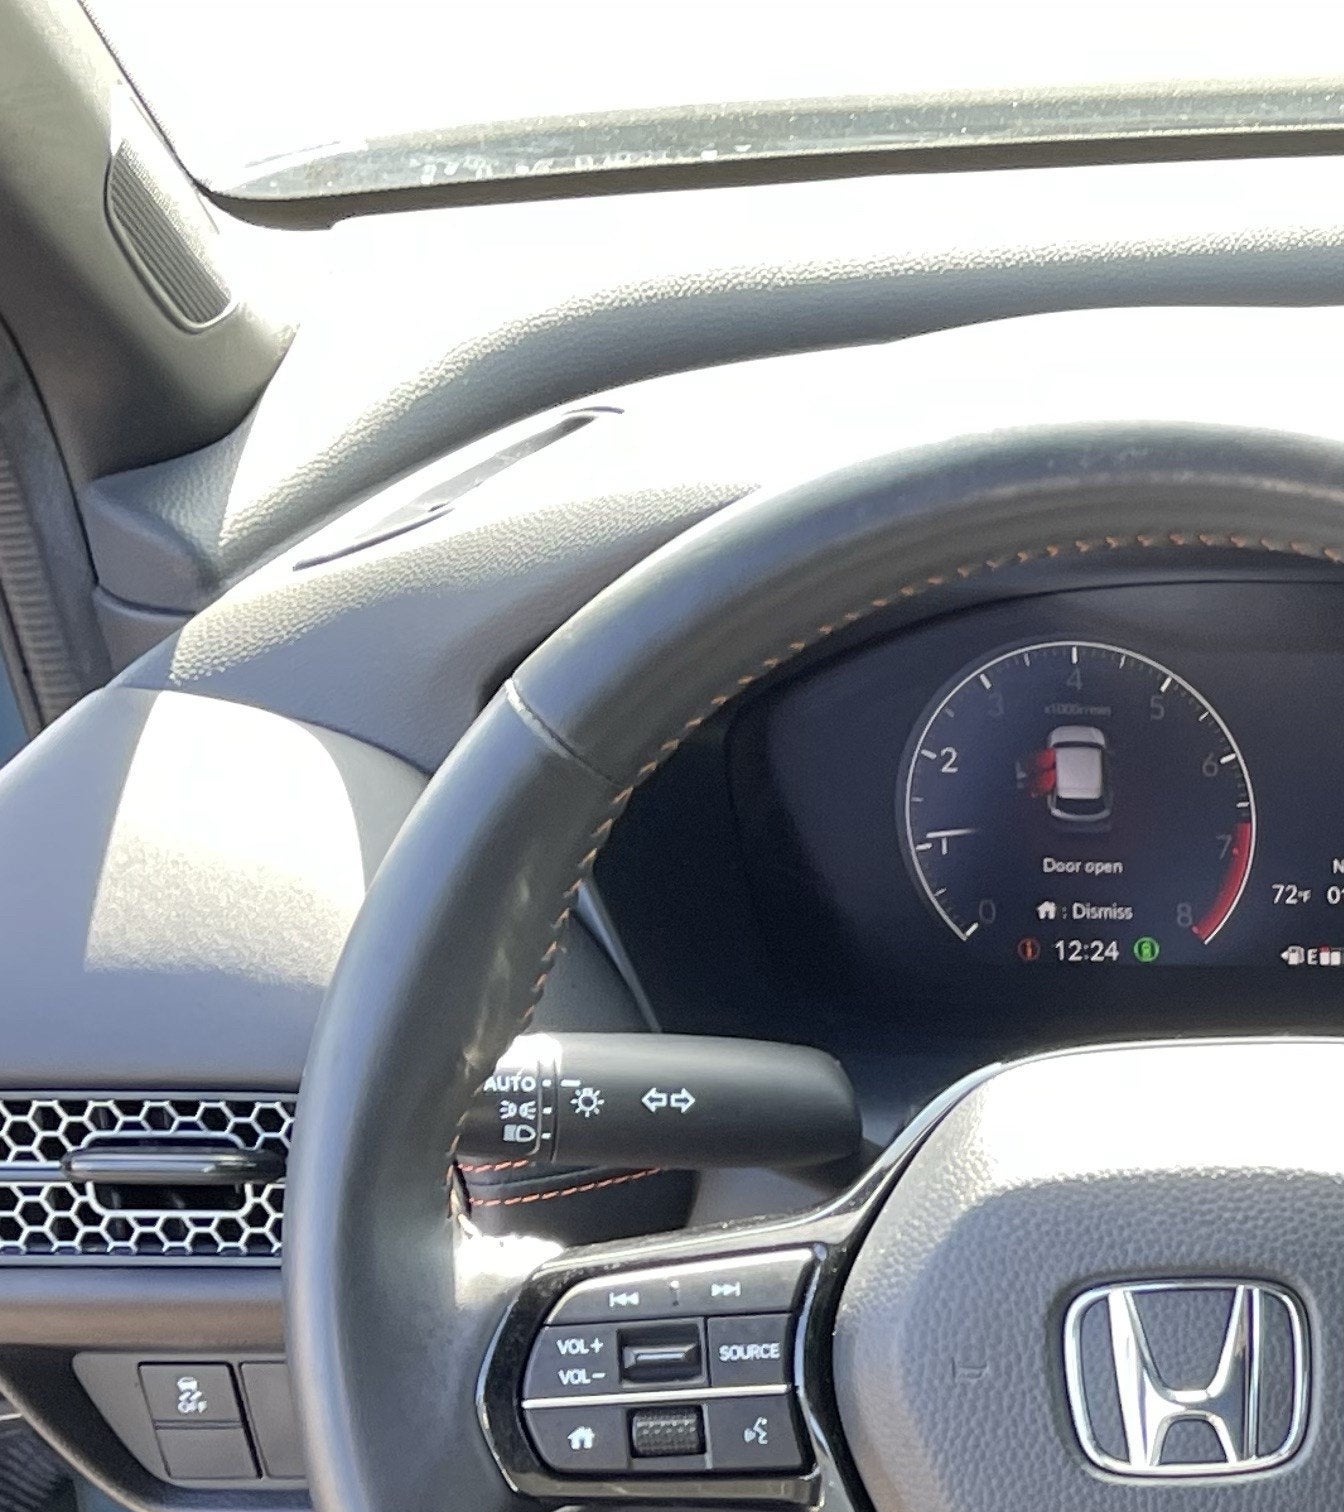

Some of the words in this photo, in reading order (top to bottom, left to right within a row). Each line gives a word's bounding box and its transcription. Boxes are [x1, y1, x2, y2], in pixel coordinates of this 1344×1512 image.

[940, 747, 959, 773] 2
[1042, 858, 1082, 874] Door
[1084, 861, 1124, 876] open
[1072, 901, 1133, 920] Dismiss
[1055, 940, 1120, 962] 12:24
[482, 1074, 537, 1093] AUTO
[718, 1342, 781, 1362] SOURCE
